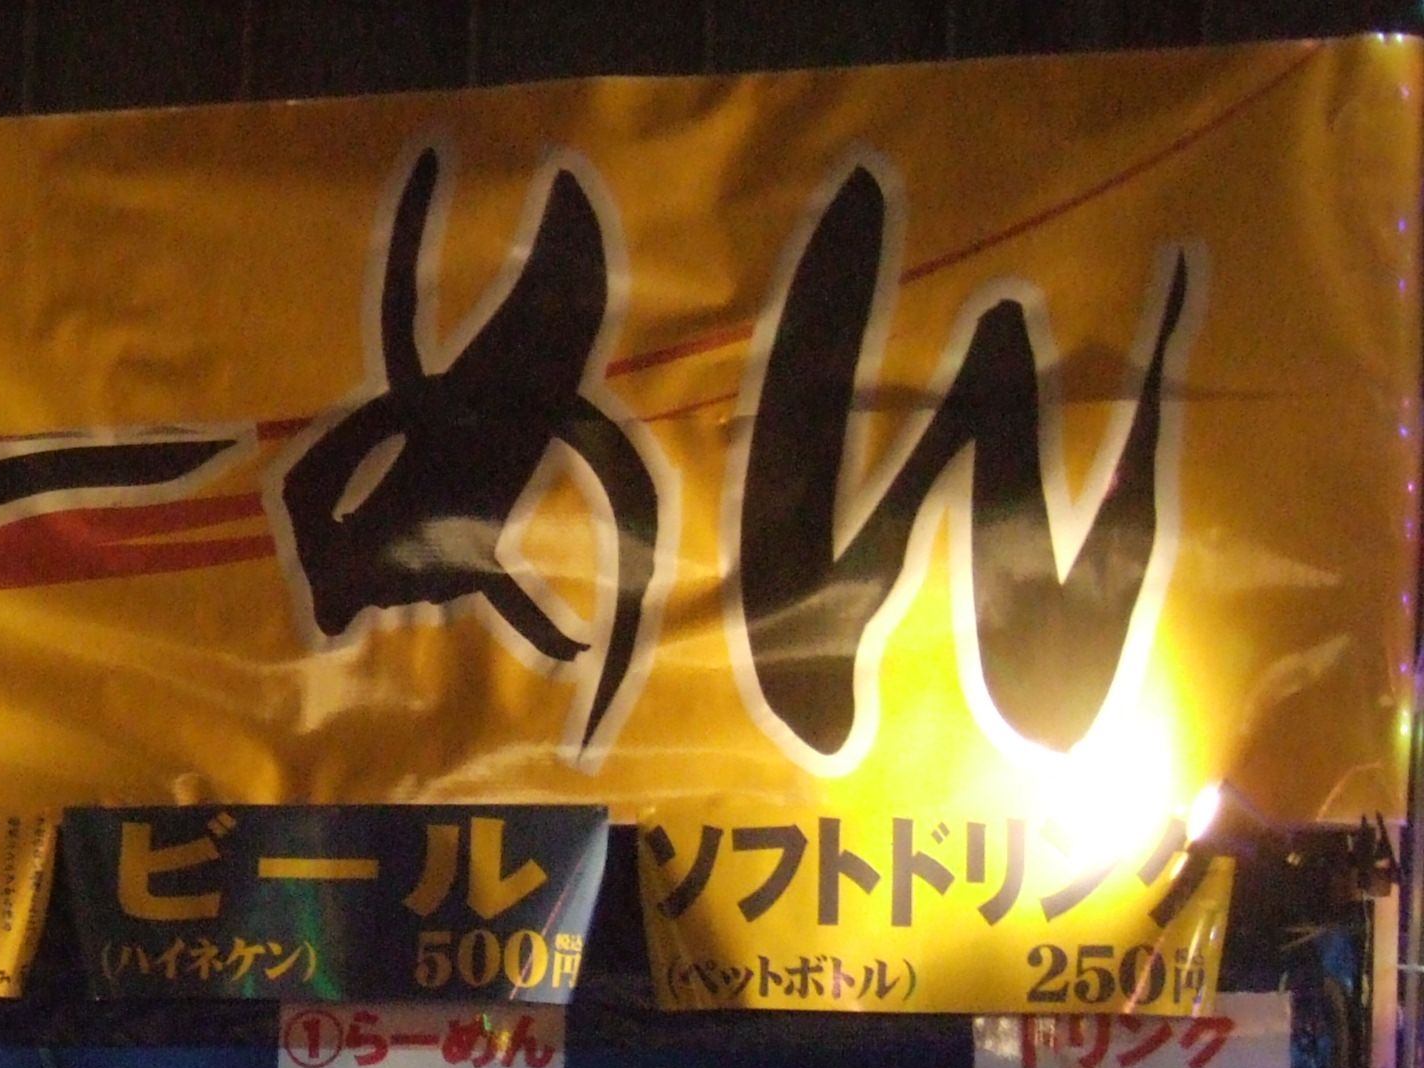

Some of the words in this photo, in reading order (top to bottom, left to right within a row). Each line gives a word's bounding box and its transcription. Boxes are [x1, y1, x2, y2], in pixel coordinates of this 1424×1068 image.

[117, 812, 549, 920] ビール
[647, 816, 1217, 929] ソフトドリンク
[100, 936, 318, 983] (ハイネケン)
[414, 929, 582, 989] 500円
[667, 953, 918, 1002] (ペットボトル)
